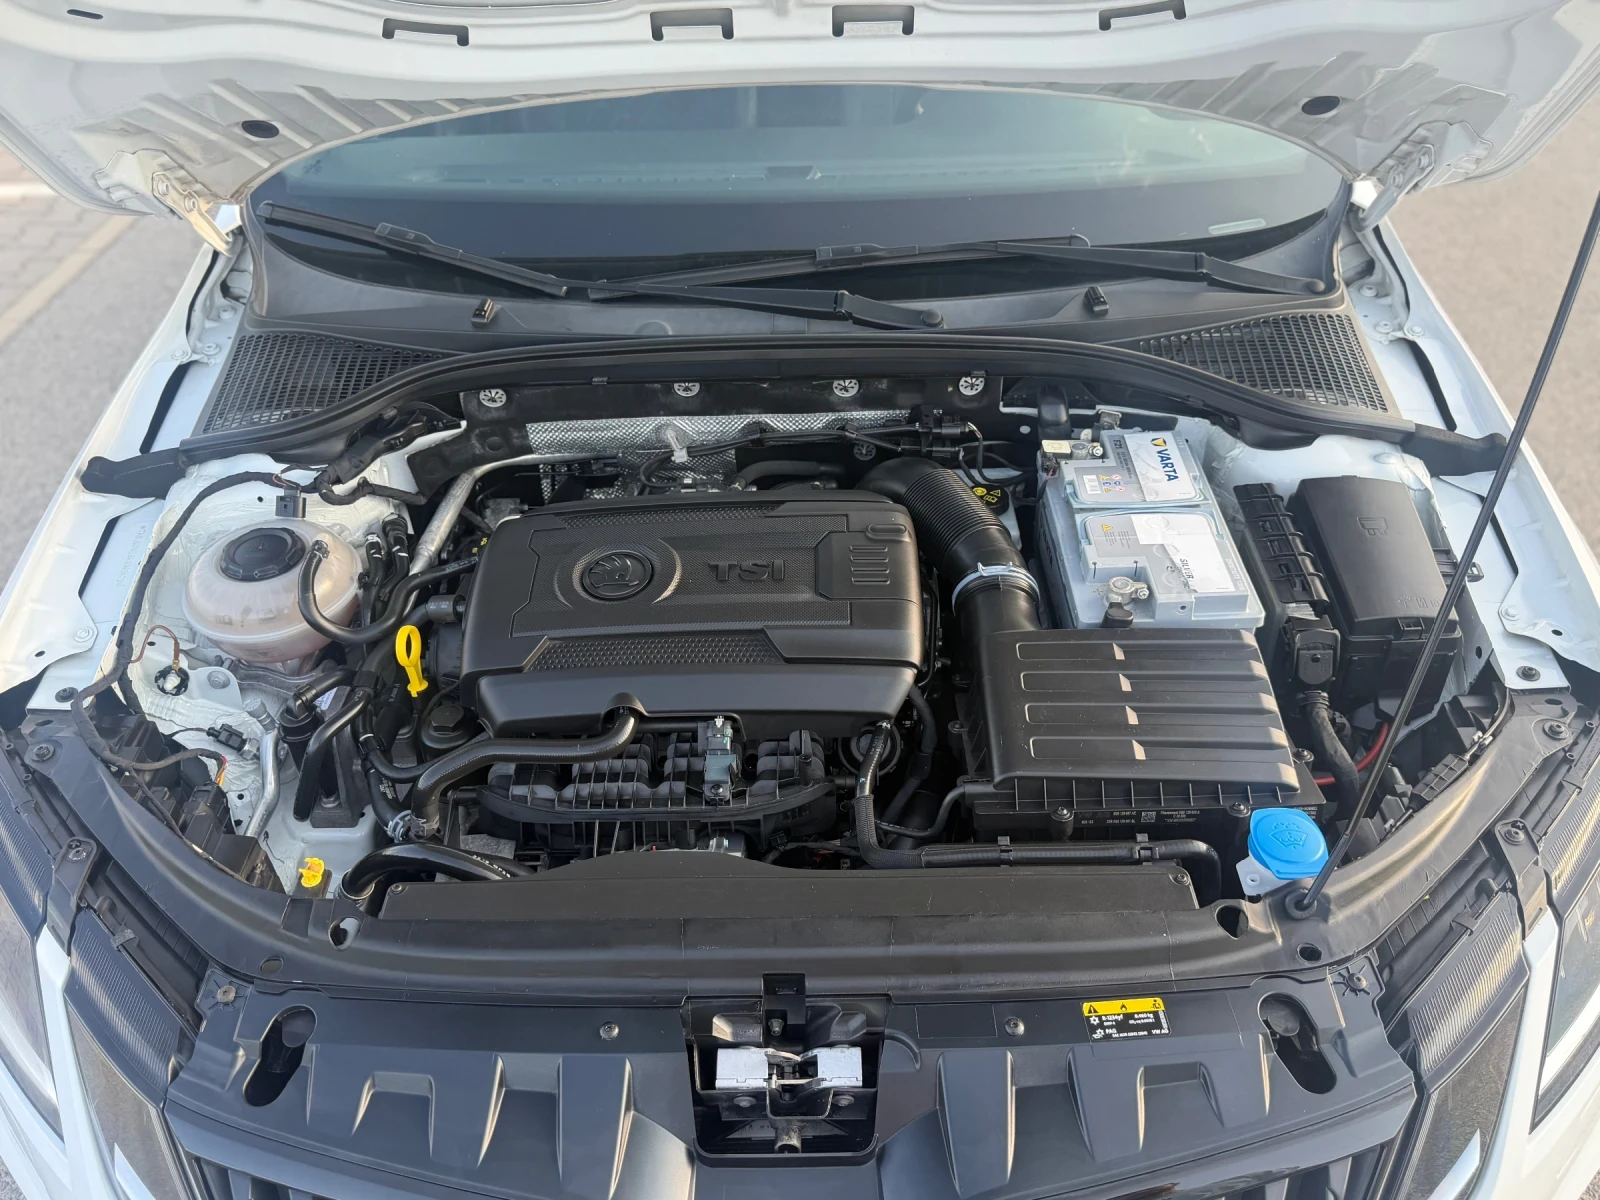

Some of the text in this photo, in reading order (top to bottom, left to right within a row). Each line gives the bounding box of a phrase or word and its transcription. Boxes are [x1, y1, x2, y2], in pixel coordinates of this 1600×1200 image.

[1156, 448, 1179, 481] VARTA
[708, 559, 785, 581] TSI
[1180, 558, 1194, 579] SILVER
